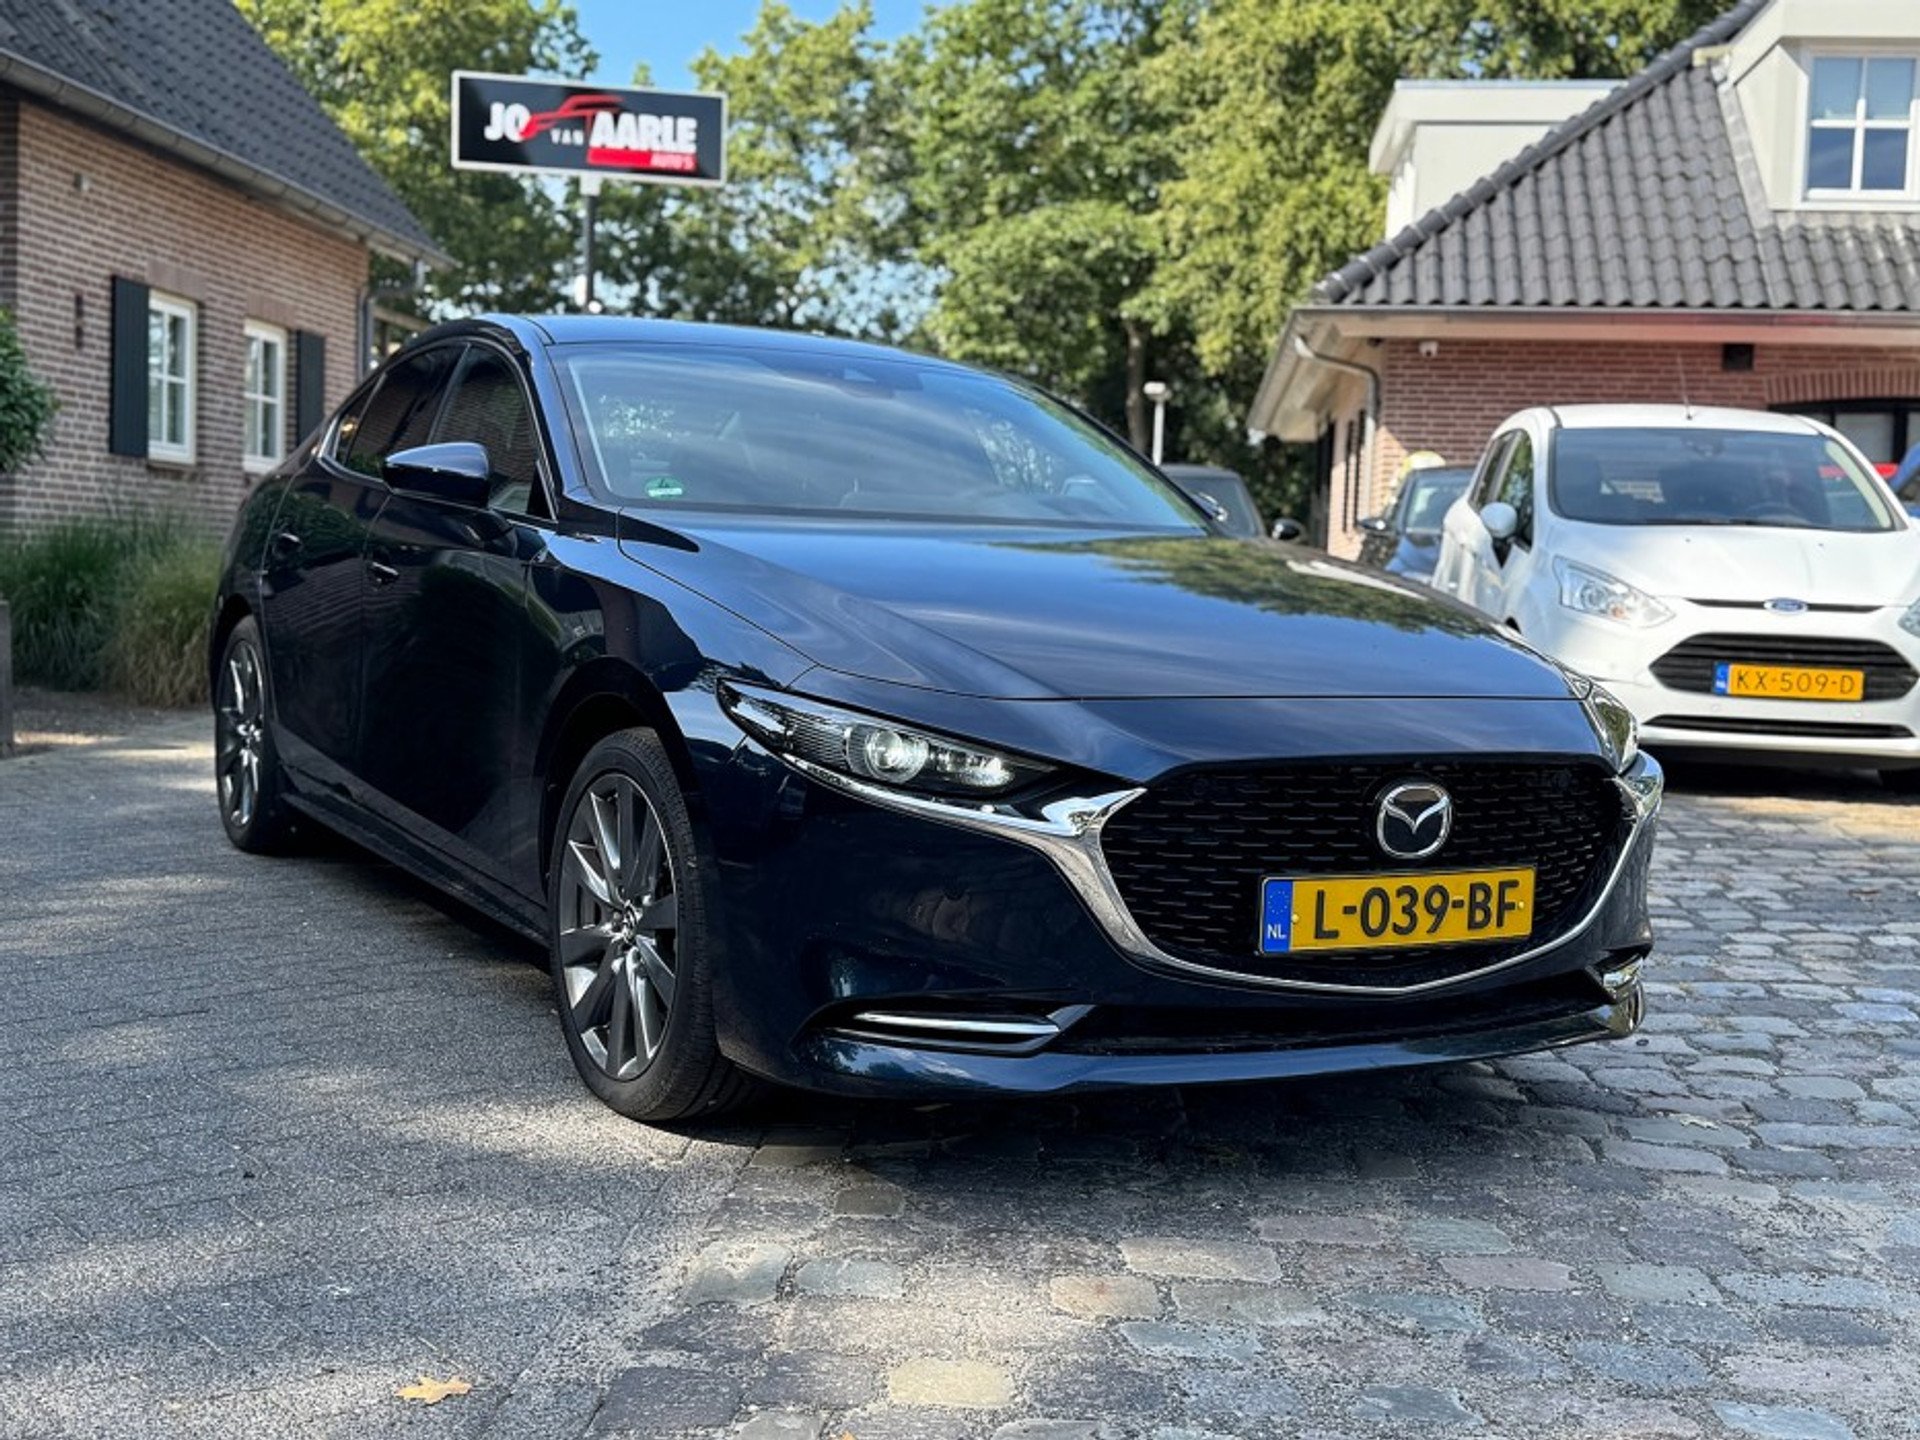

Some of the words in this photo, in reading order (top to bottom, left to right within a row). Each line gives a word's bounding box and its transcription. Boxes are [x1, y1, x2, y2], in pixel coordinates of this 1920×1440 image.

[484, 102, 532, 142] JO
[590, 111, 697, 154] AARLE
[1736, 670, 1855, 695] KX-509-D
[1313, 879, 1519, 940] L-039-BF
[1267, 924, 1287, 940] NL
